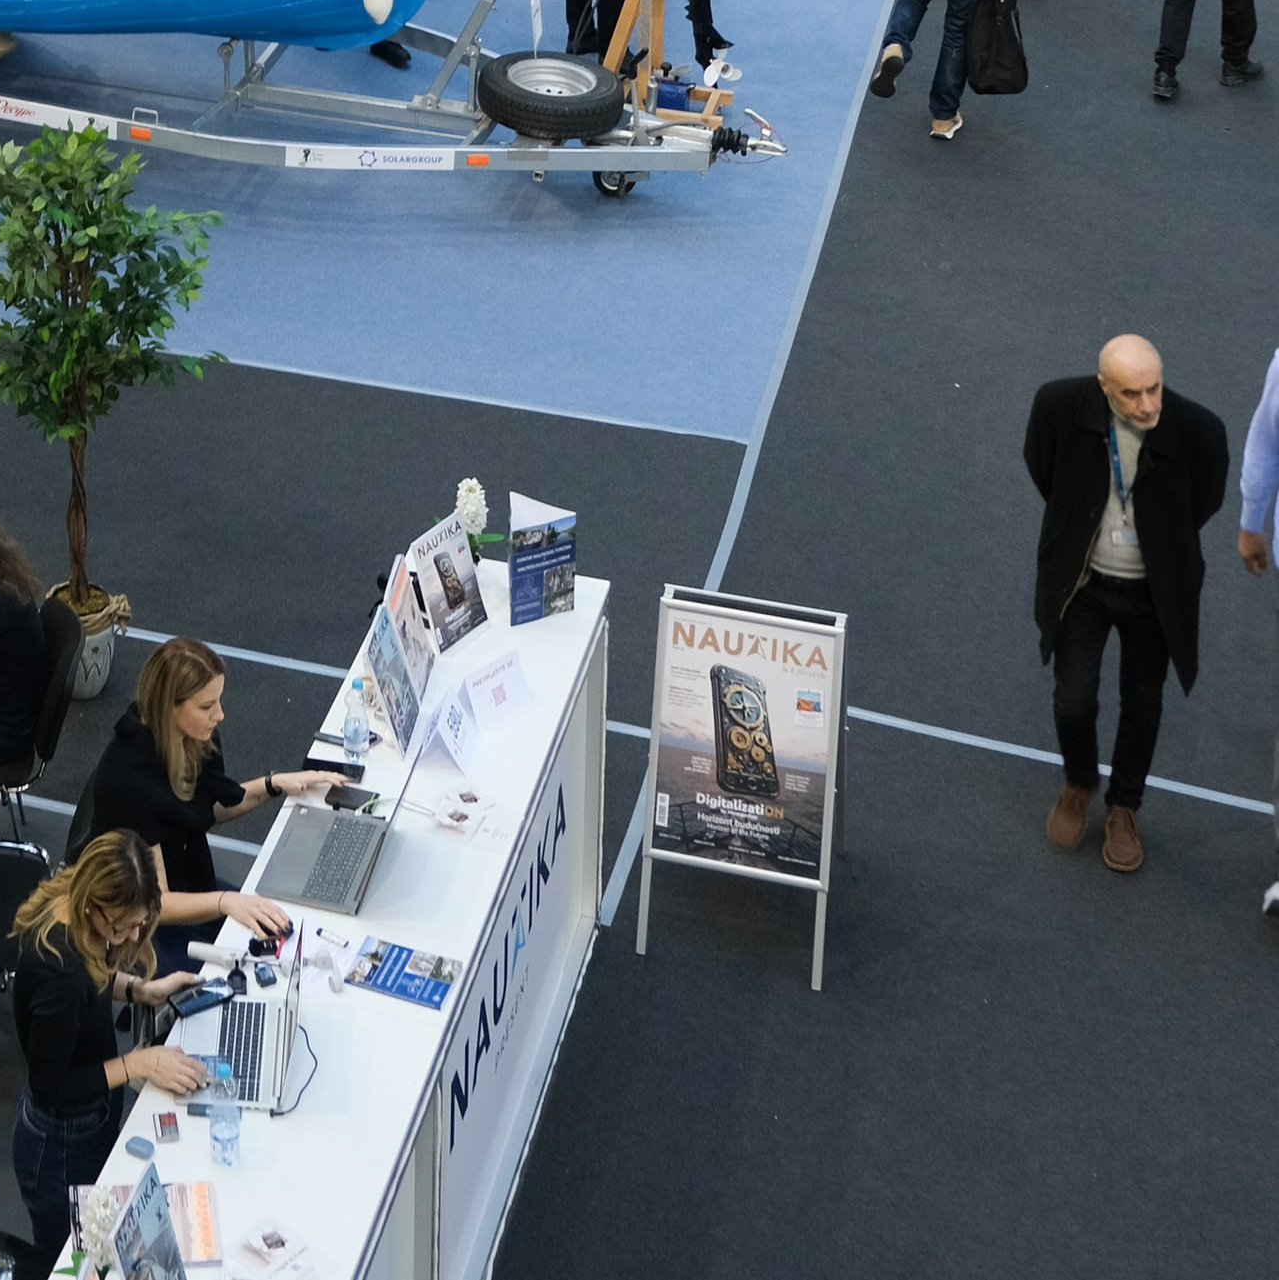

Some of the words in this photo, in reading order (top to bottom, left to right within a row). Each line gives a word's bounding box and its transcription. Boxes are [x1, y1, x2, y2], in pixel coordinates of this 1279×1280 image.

[382, 154, 444, 164] SOLARGROUP
[417, 520, 463, 559] NAUTIKA
[672, 620, 829, 672] NAUTIKA
[695, 791, 785, 820] DigitalizatiON
[697, 811, 732, 826] Horizont
[449, 782, 567, 1156] NAUTIKA
